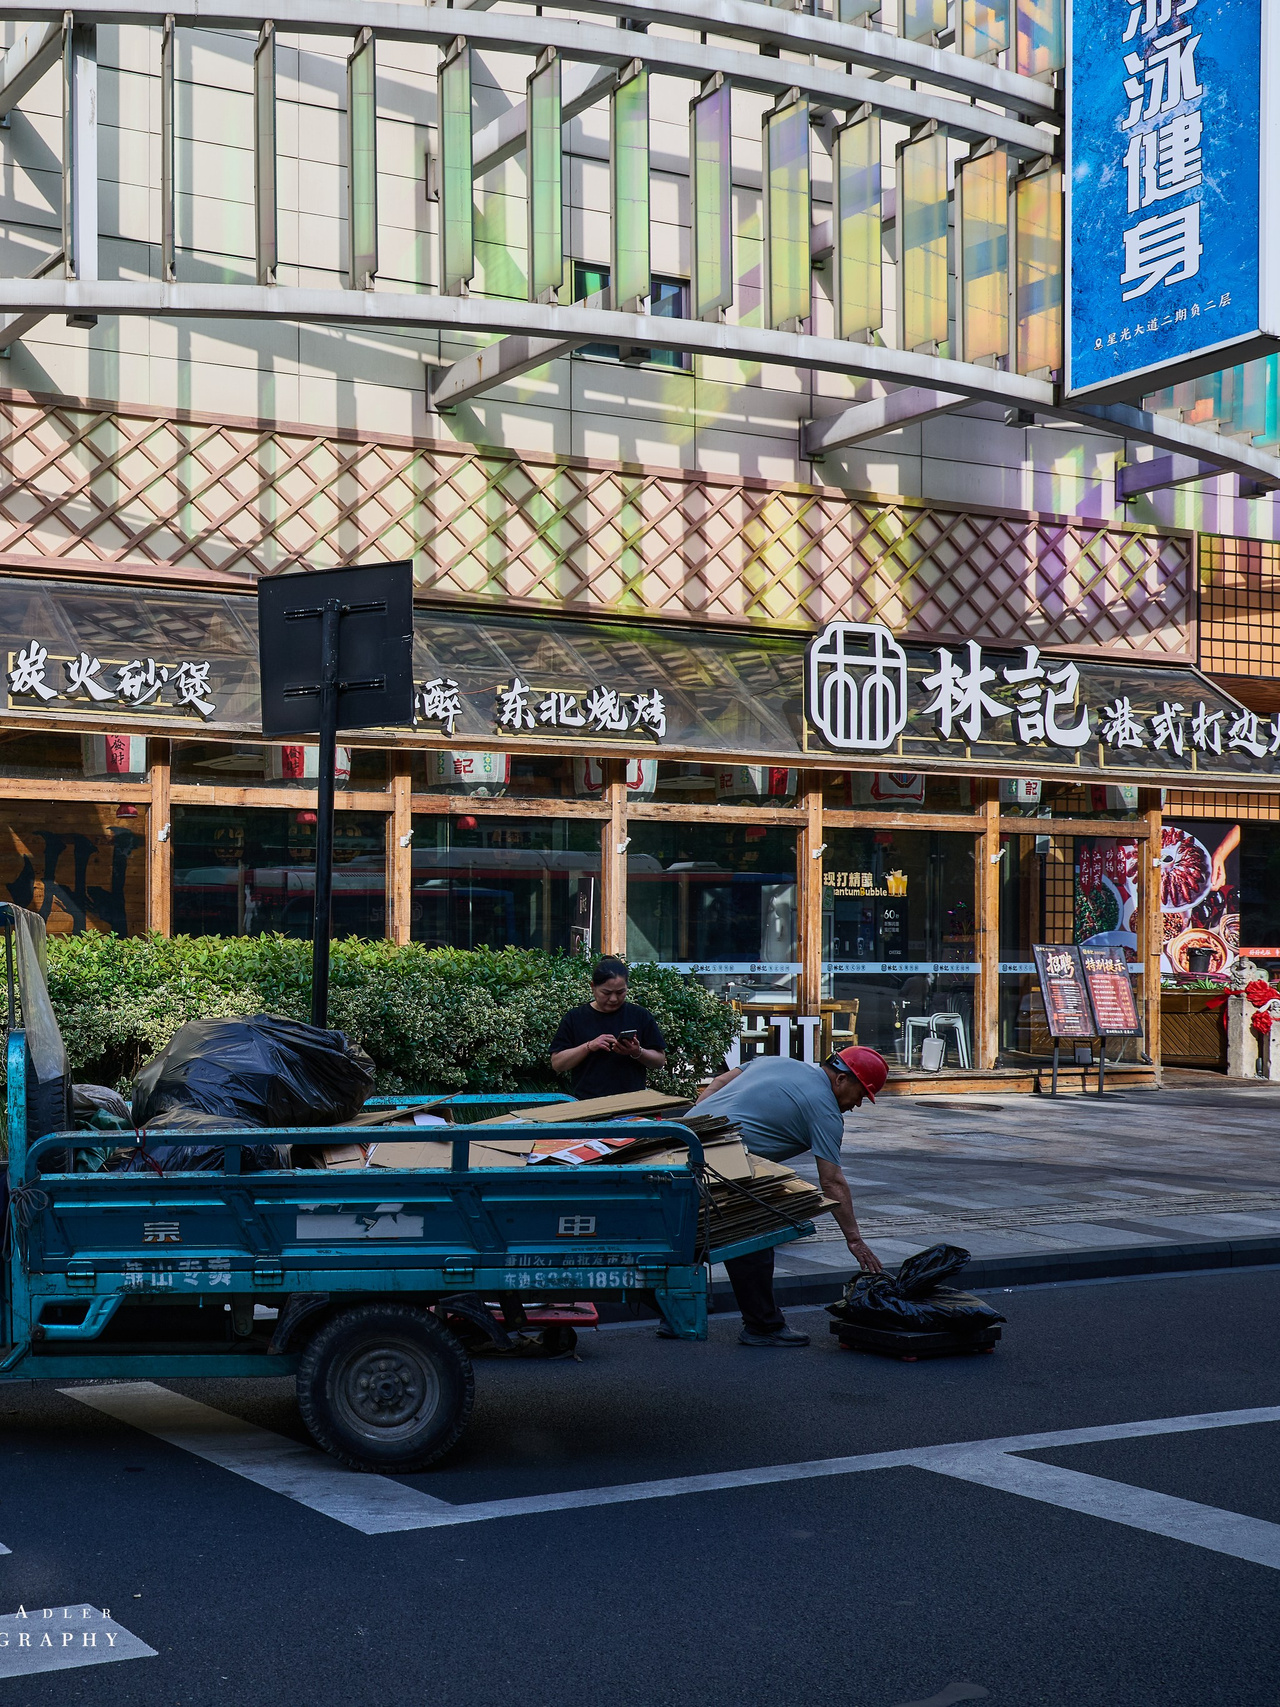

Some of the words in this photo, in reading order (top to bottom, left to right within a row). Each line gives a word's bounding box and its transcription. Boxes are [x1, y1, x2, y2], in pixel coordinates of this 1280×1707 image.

[1106, 292, 1232, 347] 星光大道二期负二层
[8, 639, 217, 720] 炭火砂煲
[921, 638, 1091, 748] 林記
[413, 677, 463, 733] 醉
[499, 677, 667, 739] 东北烧烤
[109, 734, 125, 766] 發財
[453, 757, 474, 775] 記
[1025, 781, 1038, 796] 記
[823, 871, 873, 888] 现打精酿
[1046, 951, 1075, 978] 招聘
[1085, 957, 1126, 972] 特别提示
[143, 1221, 180, 1242] 宗
[558, 1215, 596, 1236] 申
